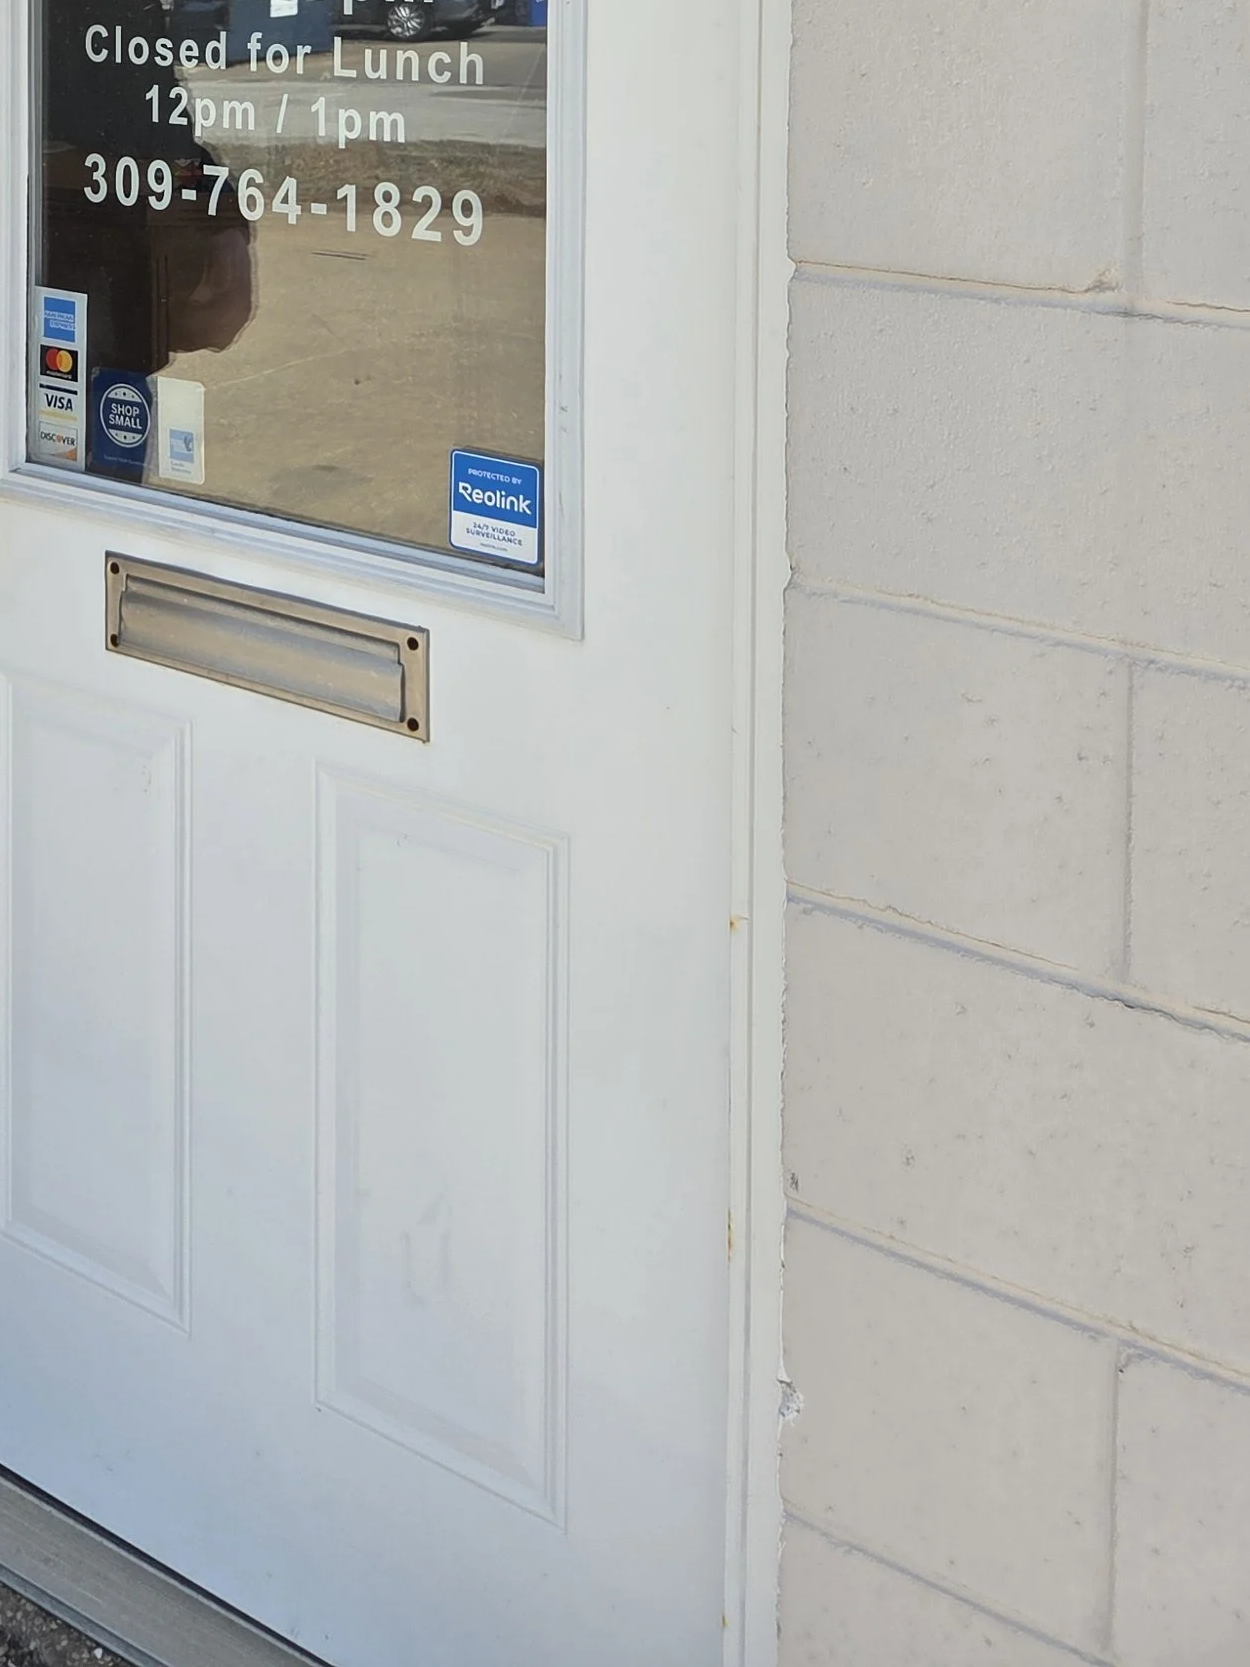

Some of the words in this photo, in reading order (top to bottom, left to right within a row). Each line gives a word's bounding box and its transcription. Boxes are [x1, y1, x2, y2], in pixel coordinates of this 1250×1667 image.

[85, 24, 227, 70] Closed
[247, 31, 312, 75] for
[333, 37, 485, 84] Lunch
[145, 84, 255, 137] 12pm
[276, 94, 288, 133] /
[310, 96, 406, 148] 1pm
[83, 153, 484, 246] 309-764-1829
[44, 393, 73, 412] VISA
[111, 403, 140, 417] SHOP
[108, 414, 142, 429] SMALL
[41, 431, 75, 446] DISCOVER
[468, 468, 510, 483] PROTECTED
[512, 476, 522, 485] BY
[458, 481, 532, 515] Reolink
[466, 527, 523, 546] SURVEILLANCE
[491, 525, 516, 537] VIDEO
